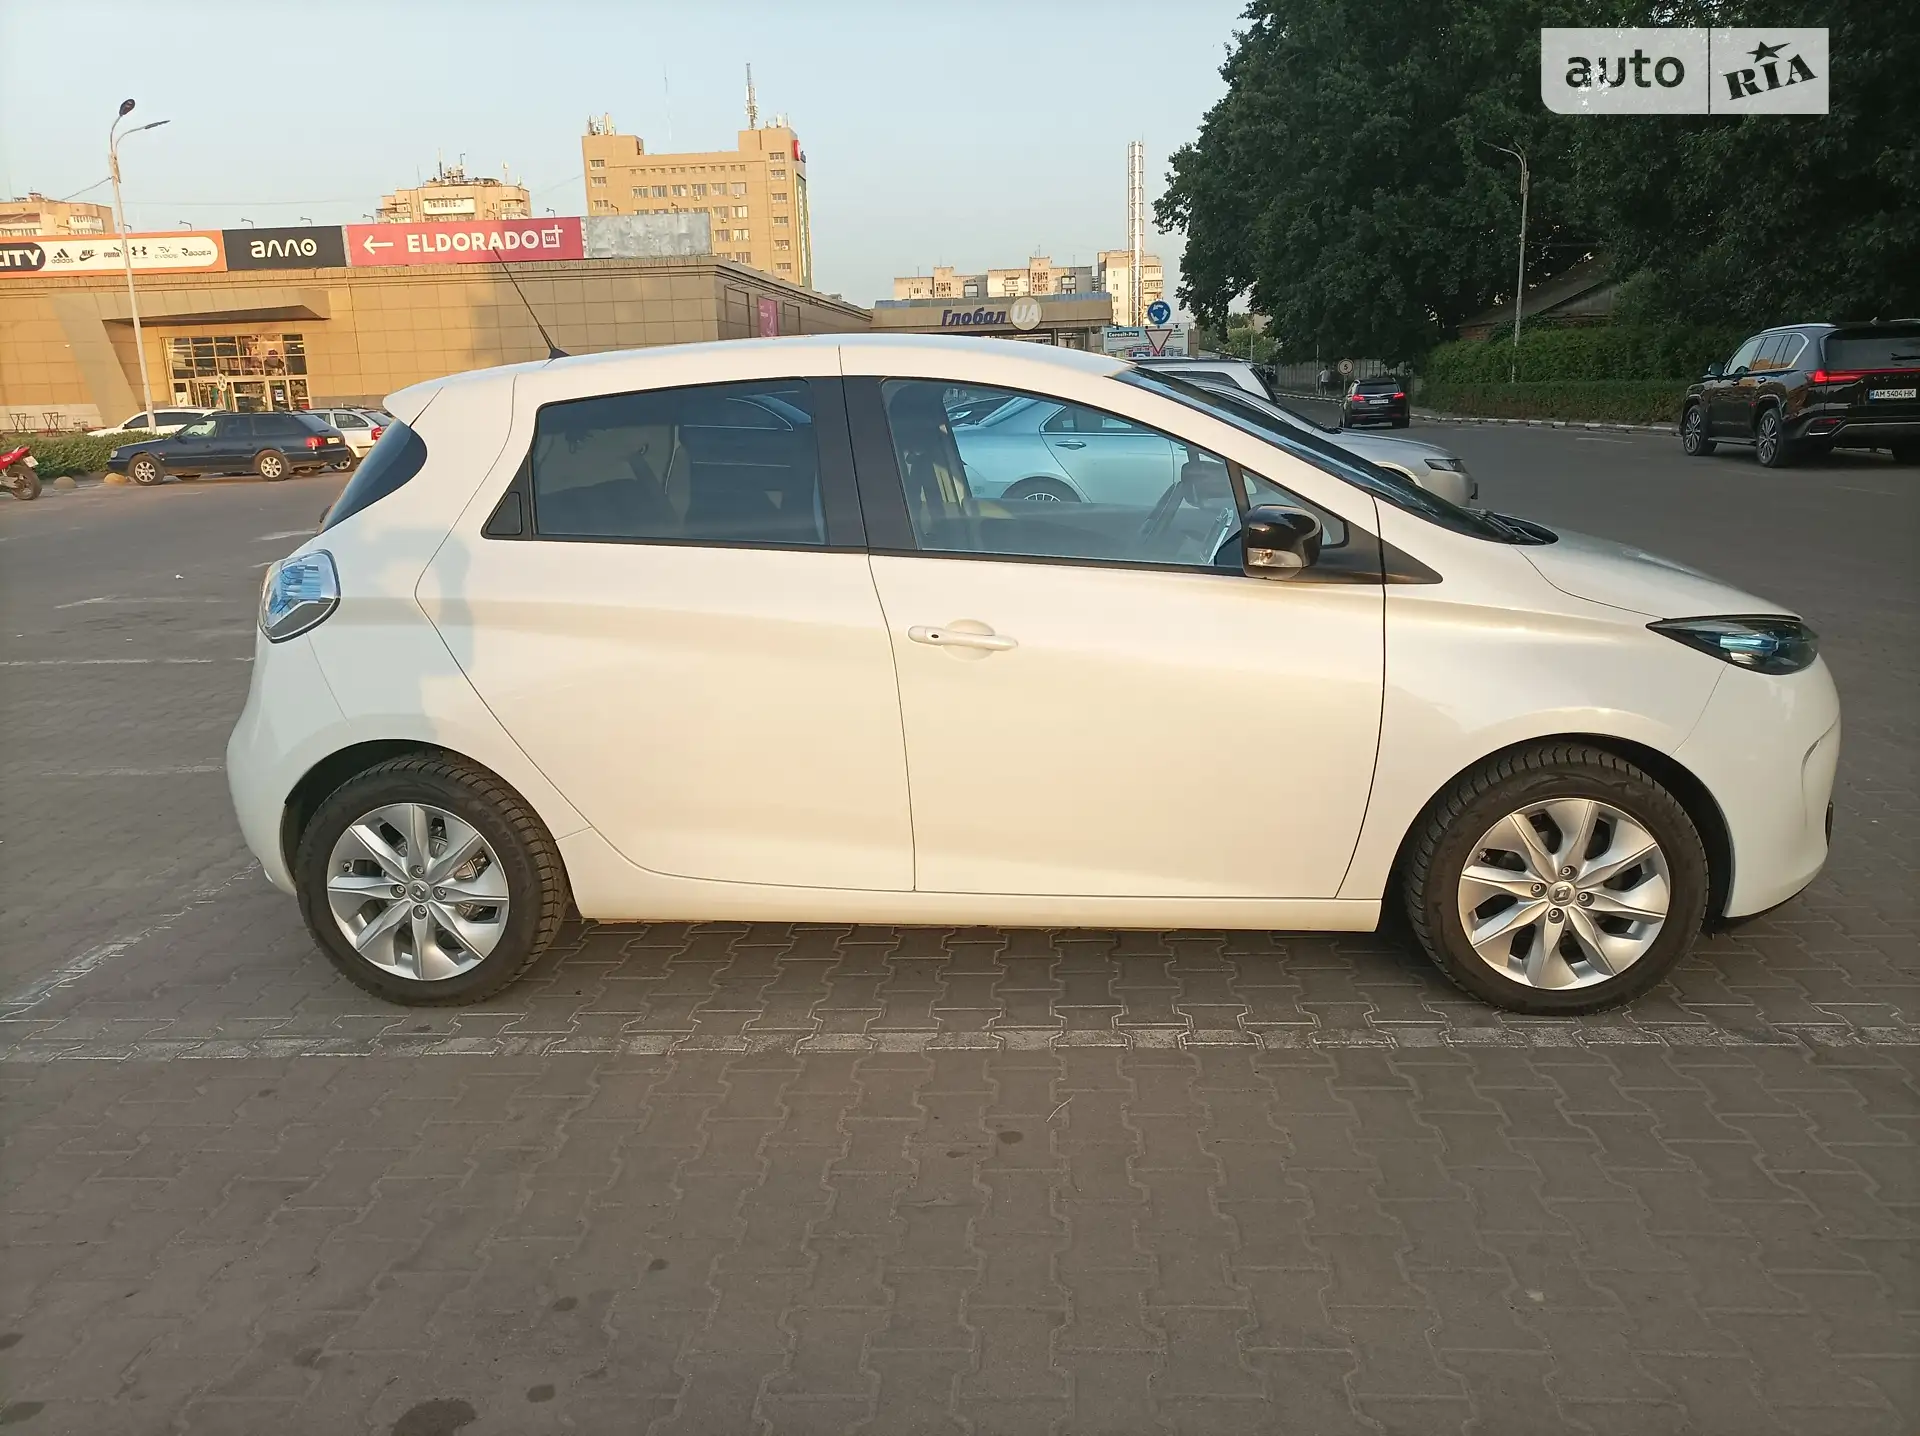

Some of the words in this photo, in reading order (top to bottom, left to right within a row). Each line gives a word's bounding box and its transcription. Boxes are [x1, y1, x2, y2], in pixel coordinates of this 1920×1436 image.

[406, 230, 540, 253] ELDORADO
[941, 307, 1006, 326] Глобал
[1013, 304, 1038, 324] UA
